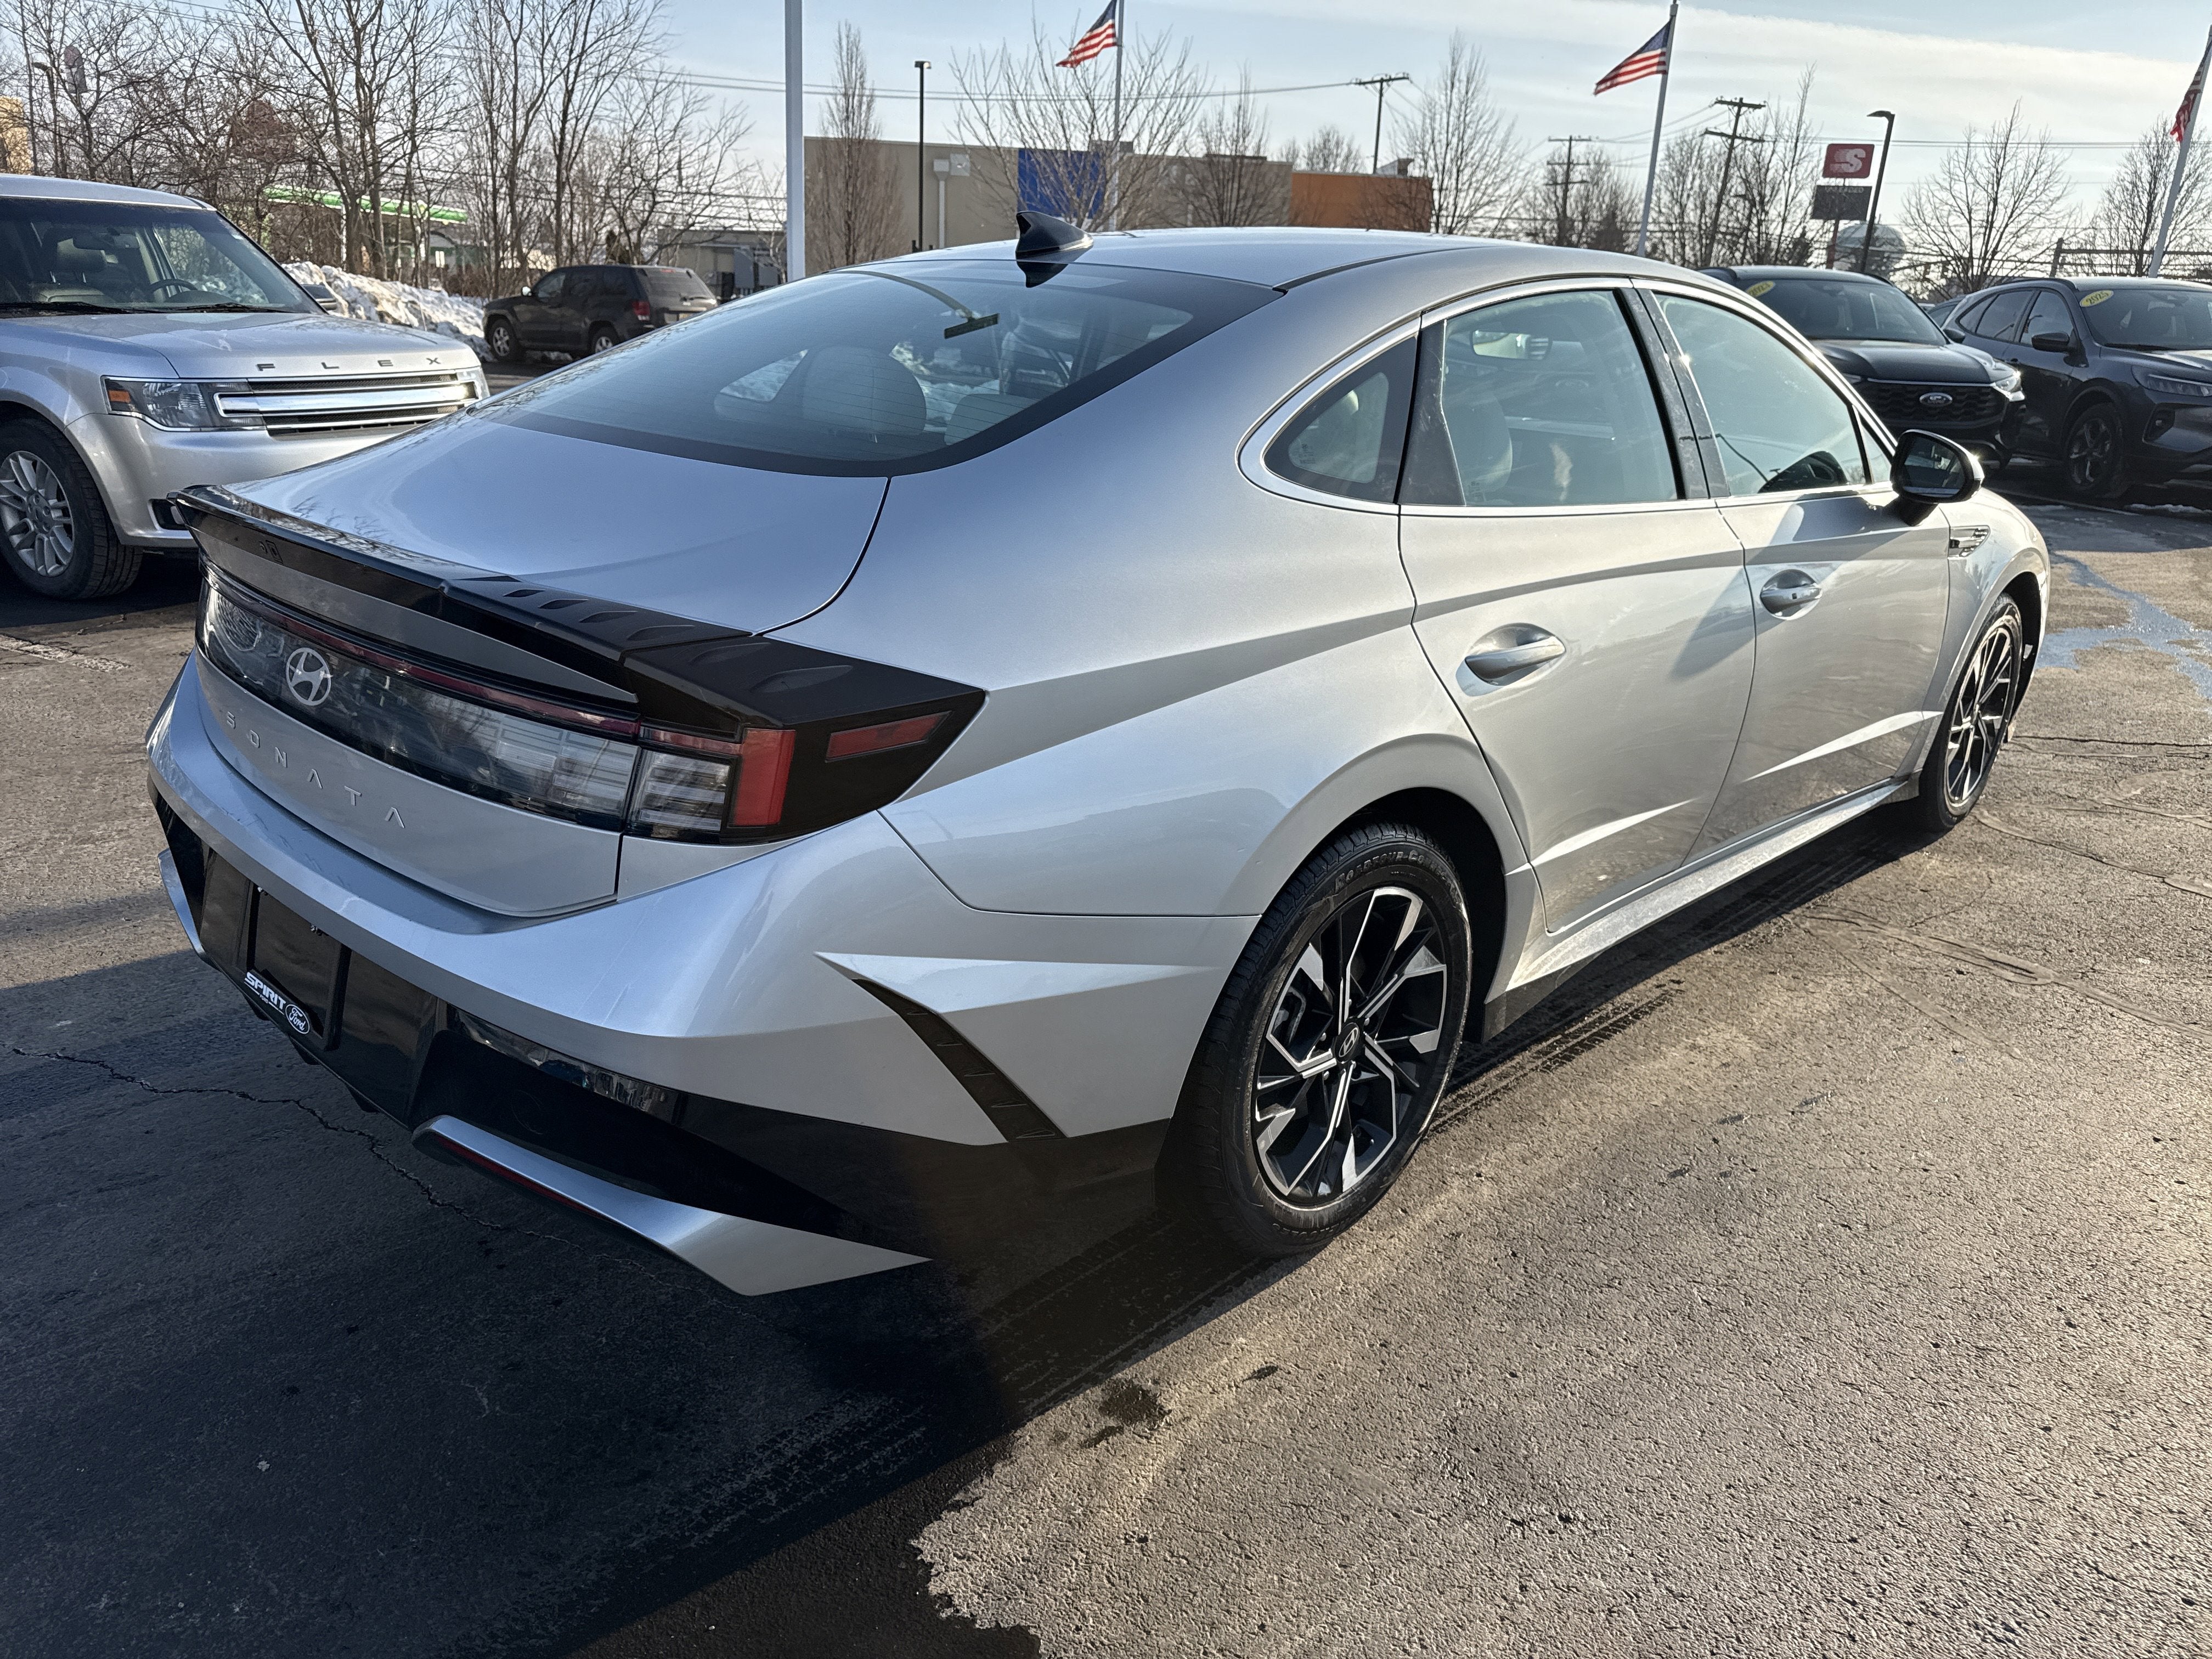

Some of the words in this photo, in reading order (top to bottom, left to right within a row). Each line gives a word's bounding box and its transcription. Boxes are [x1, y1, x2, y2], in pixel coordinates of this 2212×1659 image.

[226, 711, 405, 828] SONATA
[244, 972, 286, 1010] SPIRIT
[289, 1007, 306, 1031] Ford
